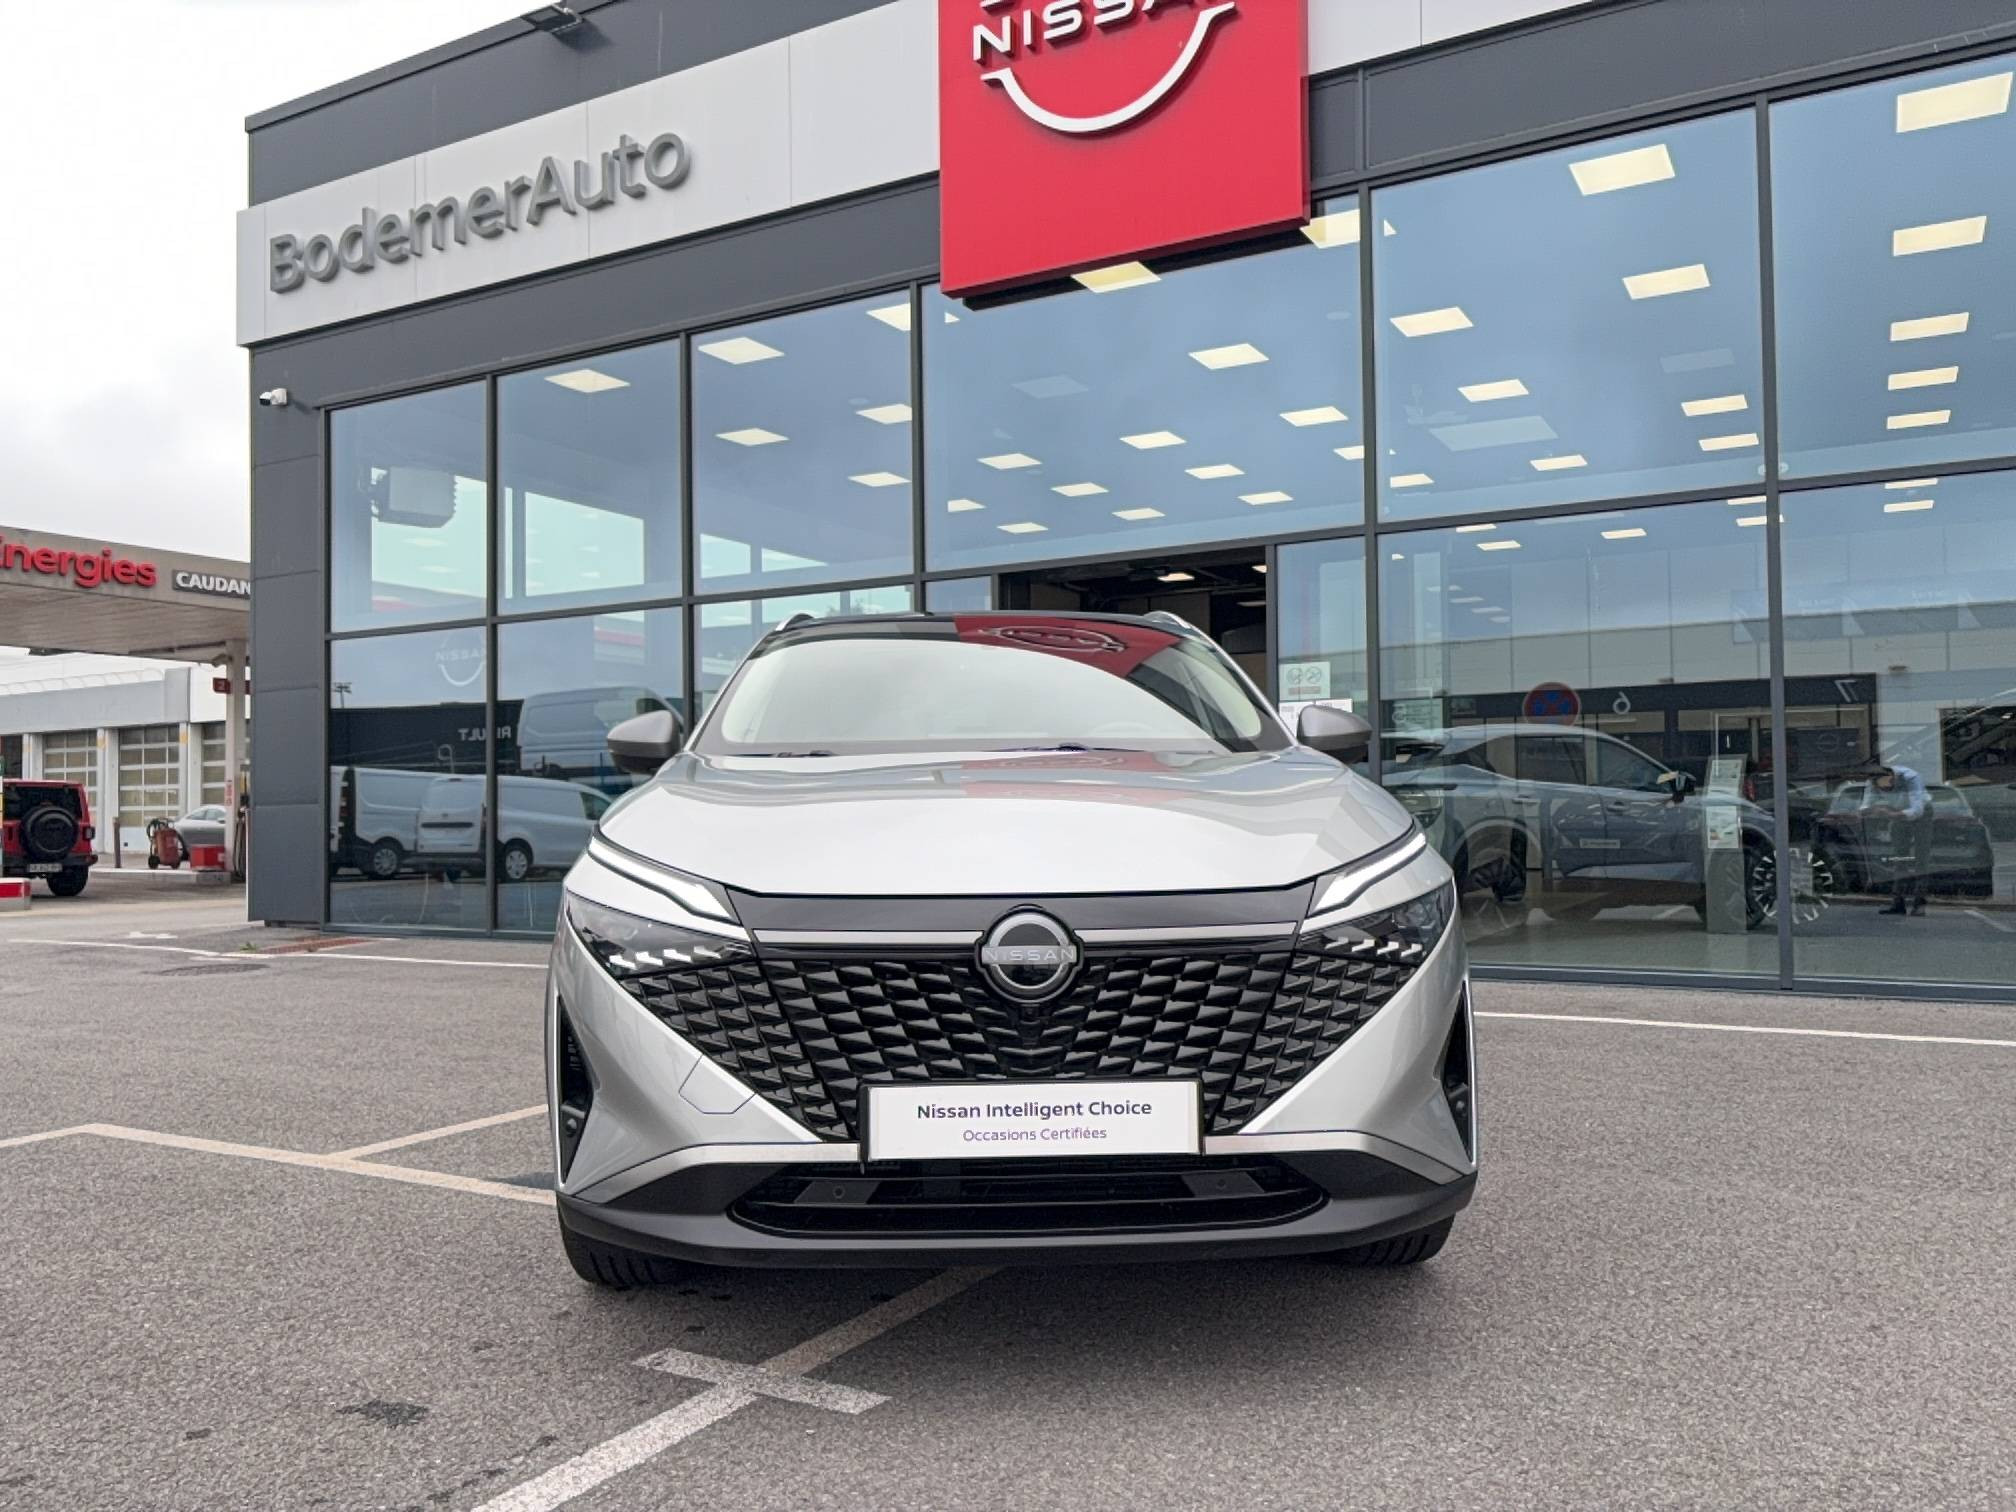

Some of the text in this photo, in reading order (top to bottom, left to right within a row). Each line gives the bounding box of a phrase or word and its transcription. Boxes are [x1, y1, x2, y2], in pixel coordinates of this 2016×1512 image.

[269, 131, 692, 294] BodemerAuto
[0, 535, 157, 588] nergies
[985, 949, 1074, 961] NISSAN
[917, 1101, 1152, 1120] Nissan Intelligent Choice
[963, 1126, 1107, 1142] Occasions Certifiées
